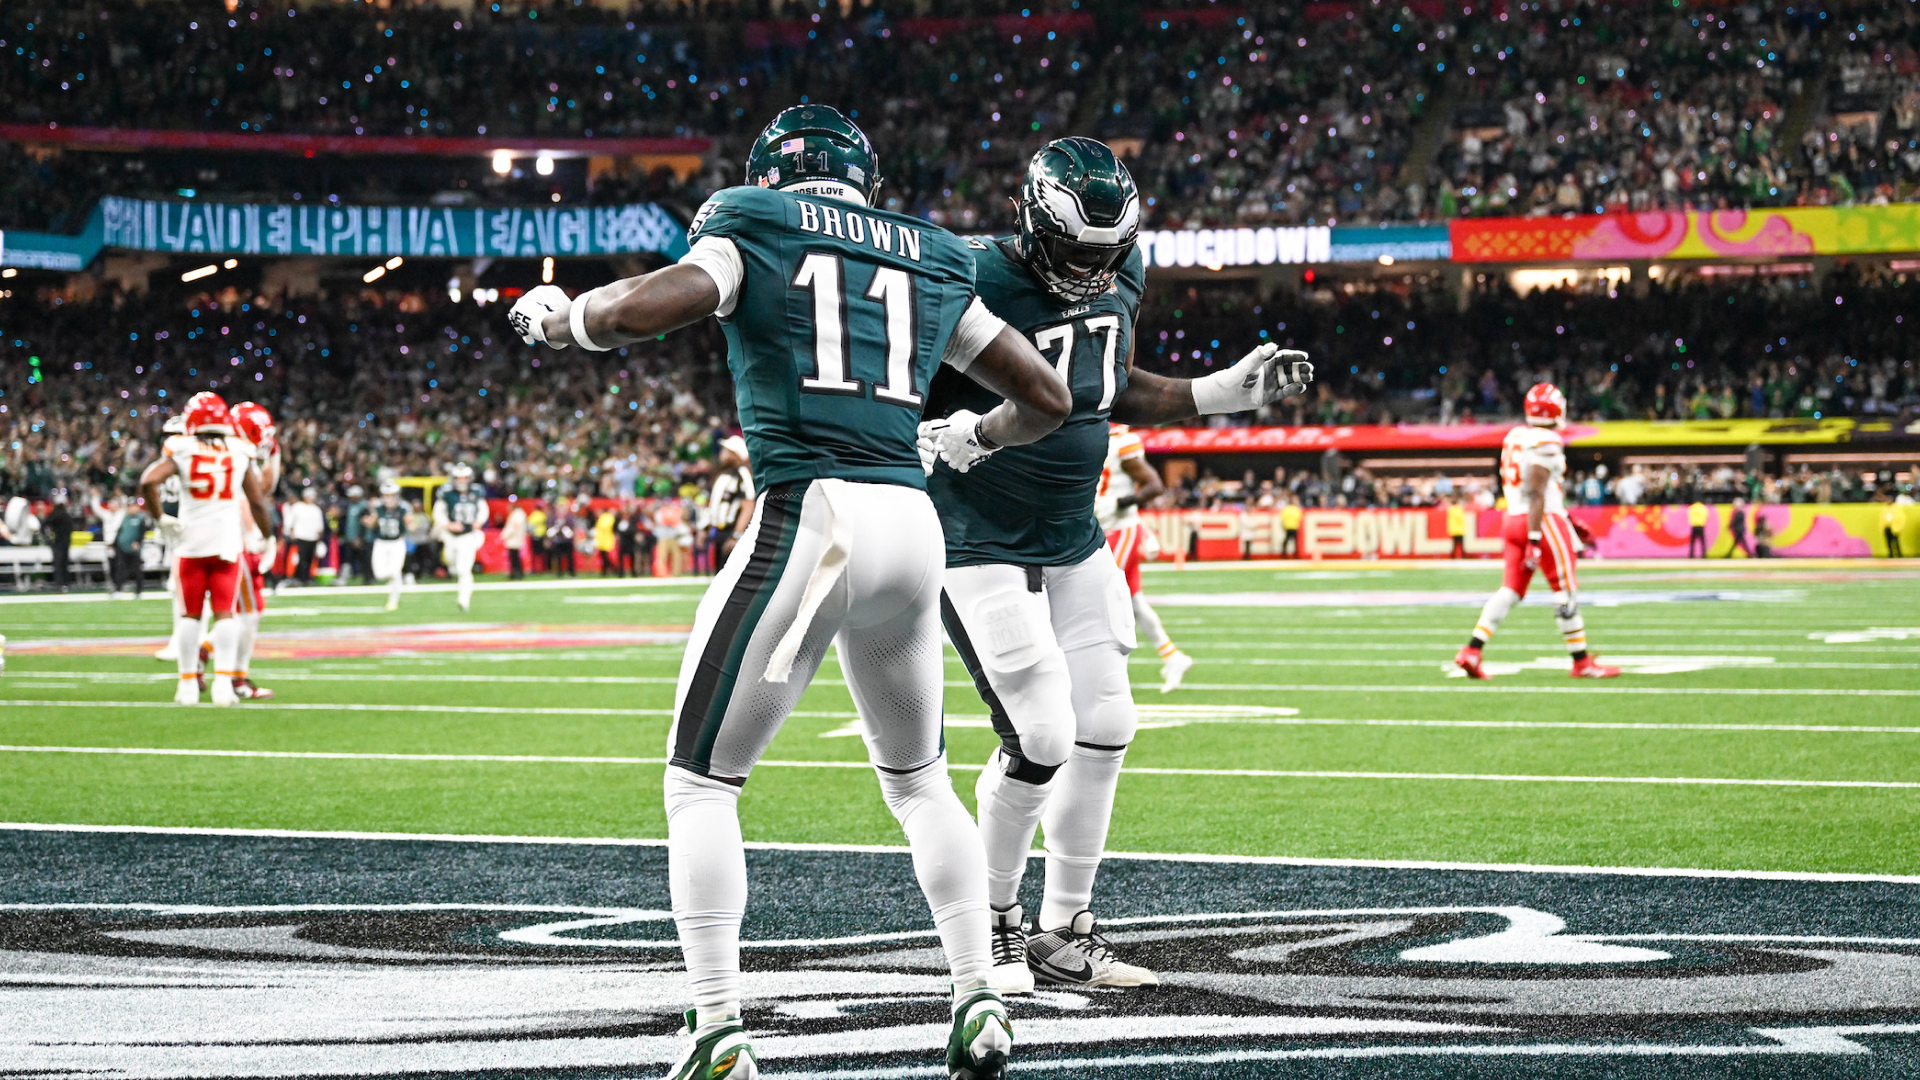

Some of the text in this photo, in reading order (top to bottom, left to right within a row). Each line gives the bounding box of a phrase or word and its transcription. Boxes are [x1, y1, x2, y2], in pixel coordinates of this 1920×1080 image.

[793, 151, 829, 172] 11
[820, 187, 844, 196] LOVE
[796, 200, 921, 263] BROWN
[1138, 225, 1331, 268] TOUCHDOWN
[789, 251, 925, 409] 11
[1061, 305, 1090, 319] EAGLES
[1034, 314, 1121, 413] 77
[189, 454, 234, 500] 51
[1304, 511, 1453, 555] BOWL
[989, 621, 1031, 650] TICKET
